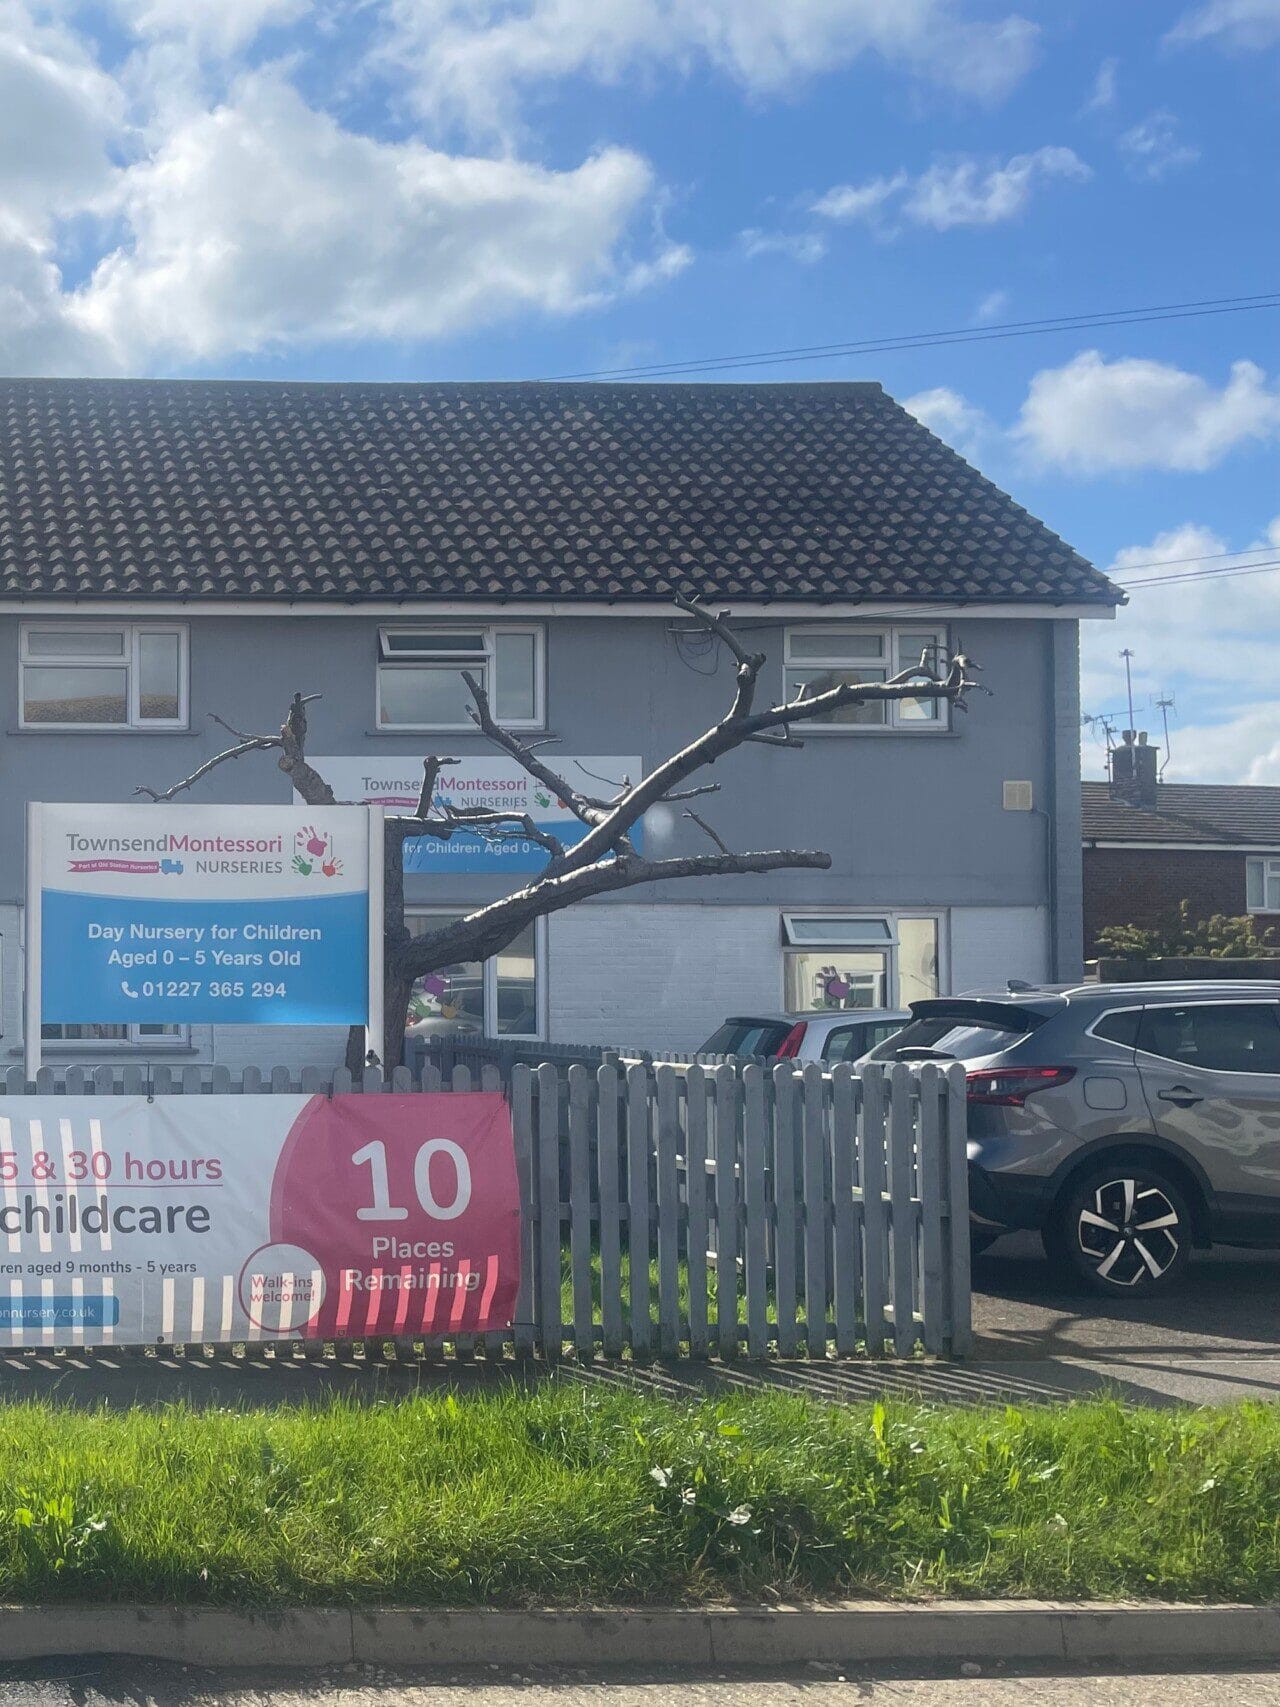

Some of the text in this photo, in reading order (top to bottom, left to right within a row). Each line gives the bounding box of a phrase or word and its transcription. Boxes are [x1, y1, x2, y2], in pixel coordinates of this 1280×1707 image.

[362, 777, 527, 791] TownsedMontessori
[461, 797, 527, 807] NURSERIES
[66, 833, 282, 852] TownsendMontessori
[404, 842, 422, 853] for
[426, 842, 481, 854] Children
[484, 842, 519, 856] Aged
[522, 843, 530, 853] 0
[196, 861, 283, 873] NURSERIES
[88, 923, 322, 943] Day Nursery for Children
[108, 950, 157, 968] Aged
[162, 950, 174, 965] 0
[194, 950, 206, 965] 5
[211, 950, 263, 966] Years
[268, 950, 301, 966] Old
[142, 981, 287, 998] 01227 365 294
[31, 1151, 57, 1180] &
[68, 1150, 112, 1180] 30
[125, 1152, 223, 1181] hours
[351, 1138, 472, 1221] 10
[372, 1236, 455, 1259] Places
[27, 1261, 61, 1278] aged
[65, 1261, 75, 1273] 9
[79, 1261, 132, 1273] months
[147, 1261, 156, 1273] 5
[160, 1262, 198, 1276] years
[252, 1275, 314, 1288] Walk-ins
[345, 1267, 481, 1292] Remaining
[250, 1290, 315, 1302] welcome!
